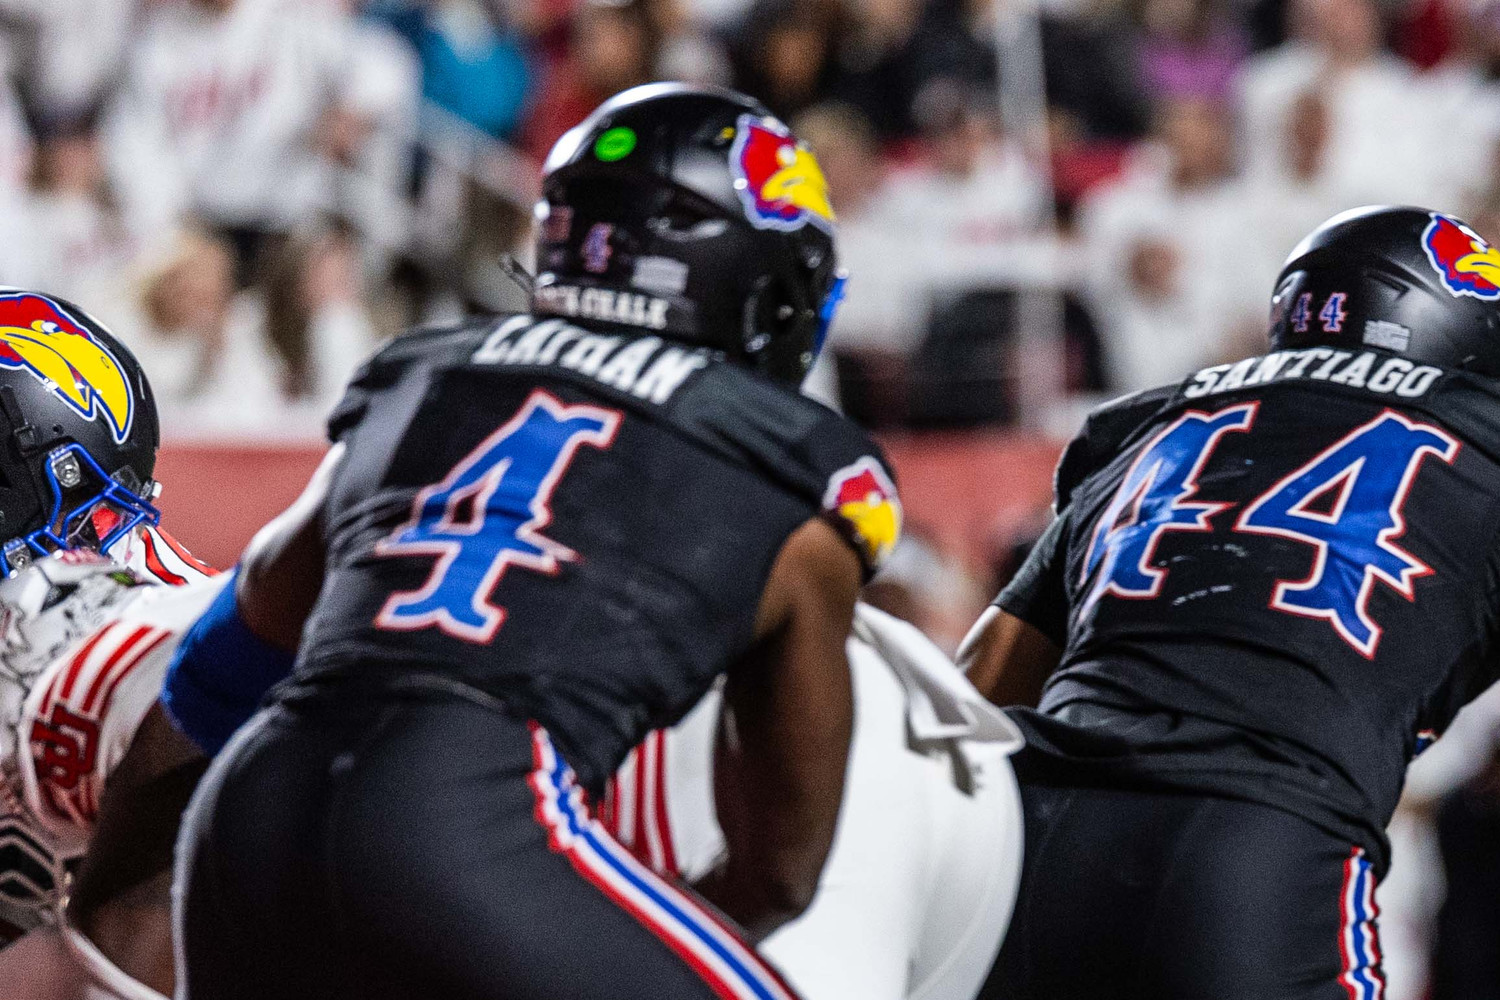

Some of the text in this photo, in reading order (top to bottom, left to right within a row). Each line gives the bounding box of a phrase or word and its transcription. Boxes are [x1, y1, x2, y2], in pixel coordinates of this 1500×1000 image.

[1185, 347, 1443, 398] SANTIAGO
[1291, 292, 1348, 333] 44
[374, 388, 624, 643] 4
[1079, 402, 1462, 660] 44
